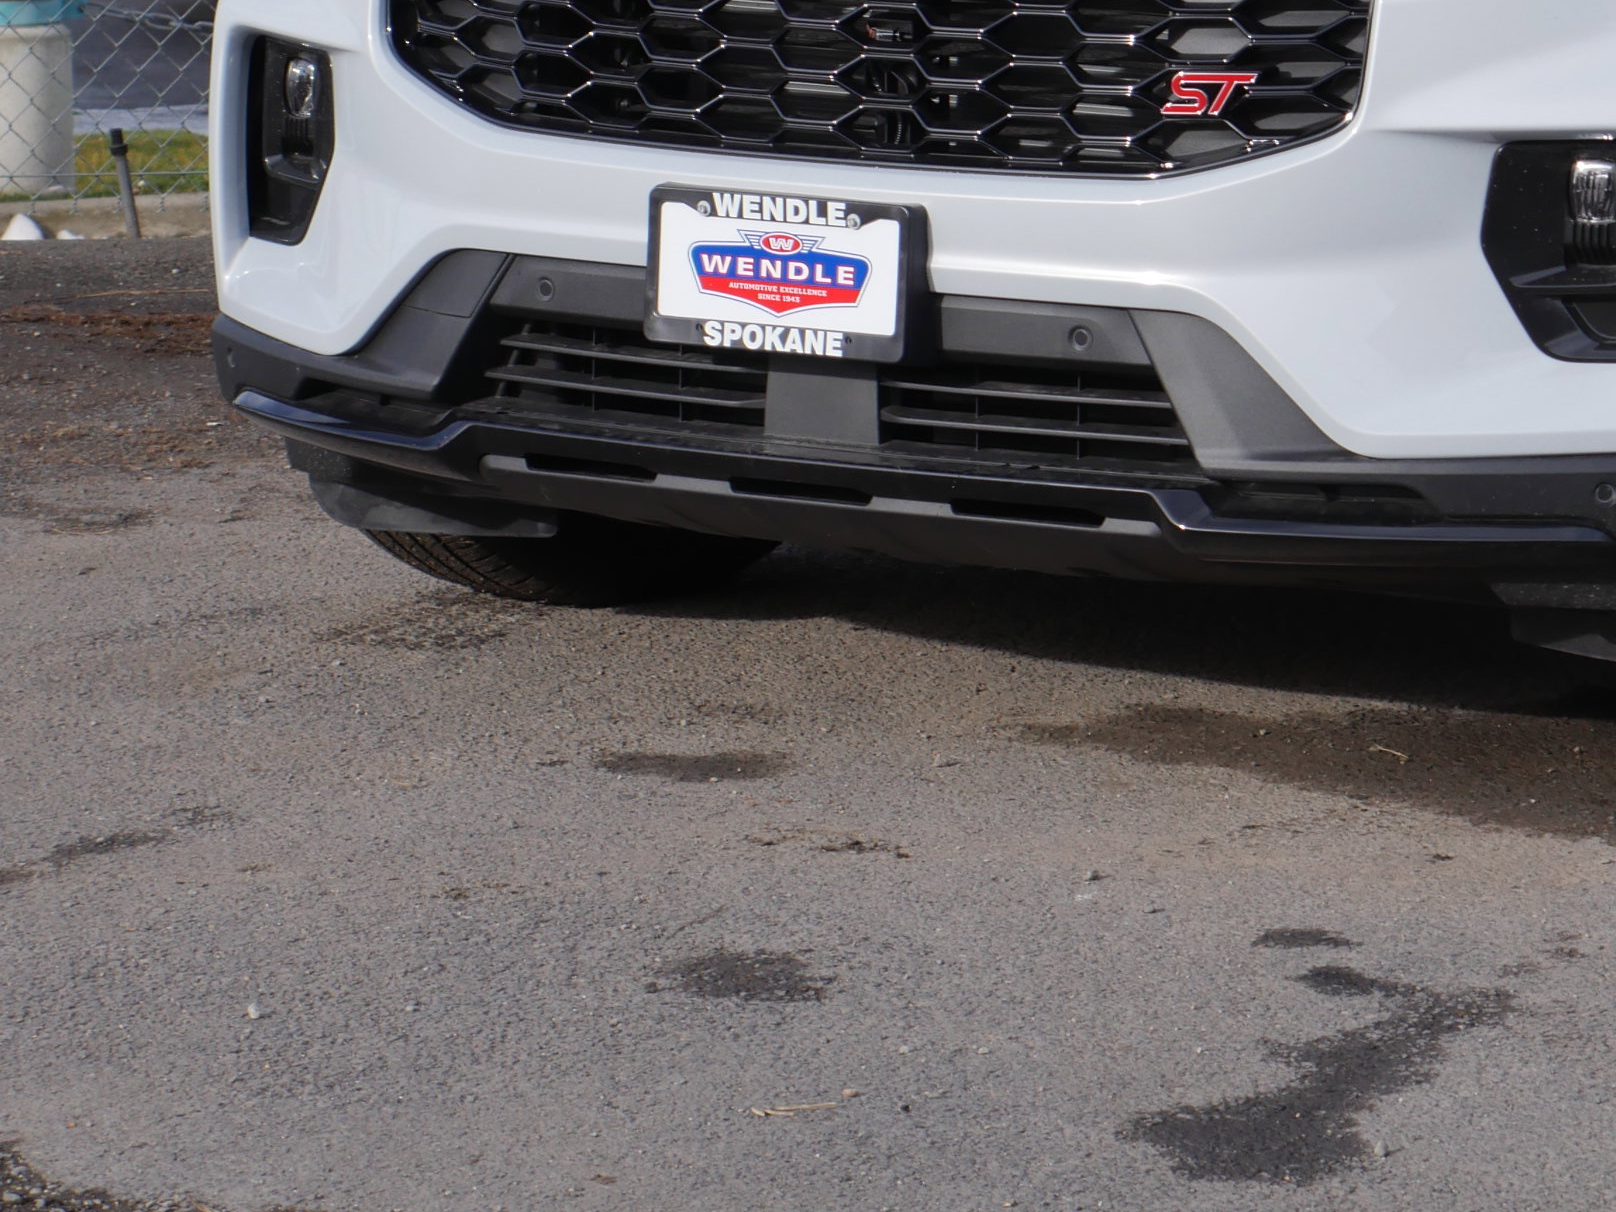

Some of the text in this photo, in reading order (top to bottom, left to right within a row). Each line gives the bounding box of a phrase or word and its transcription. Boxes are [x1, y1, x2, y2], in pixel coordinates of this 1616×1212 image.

[1161, 72, 1258, 115] ST
[712, 192, 848, 227] WENDLE
[700, 253, 855, 285] WENDLE
[728, 281, 827, 297] AUTOMOTIVE EXCELLENCE
[757, 293, 780, 302] SINCE
[703, 320, 843, 357] SPOKANE
